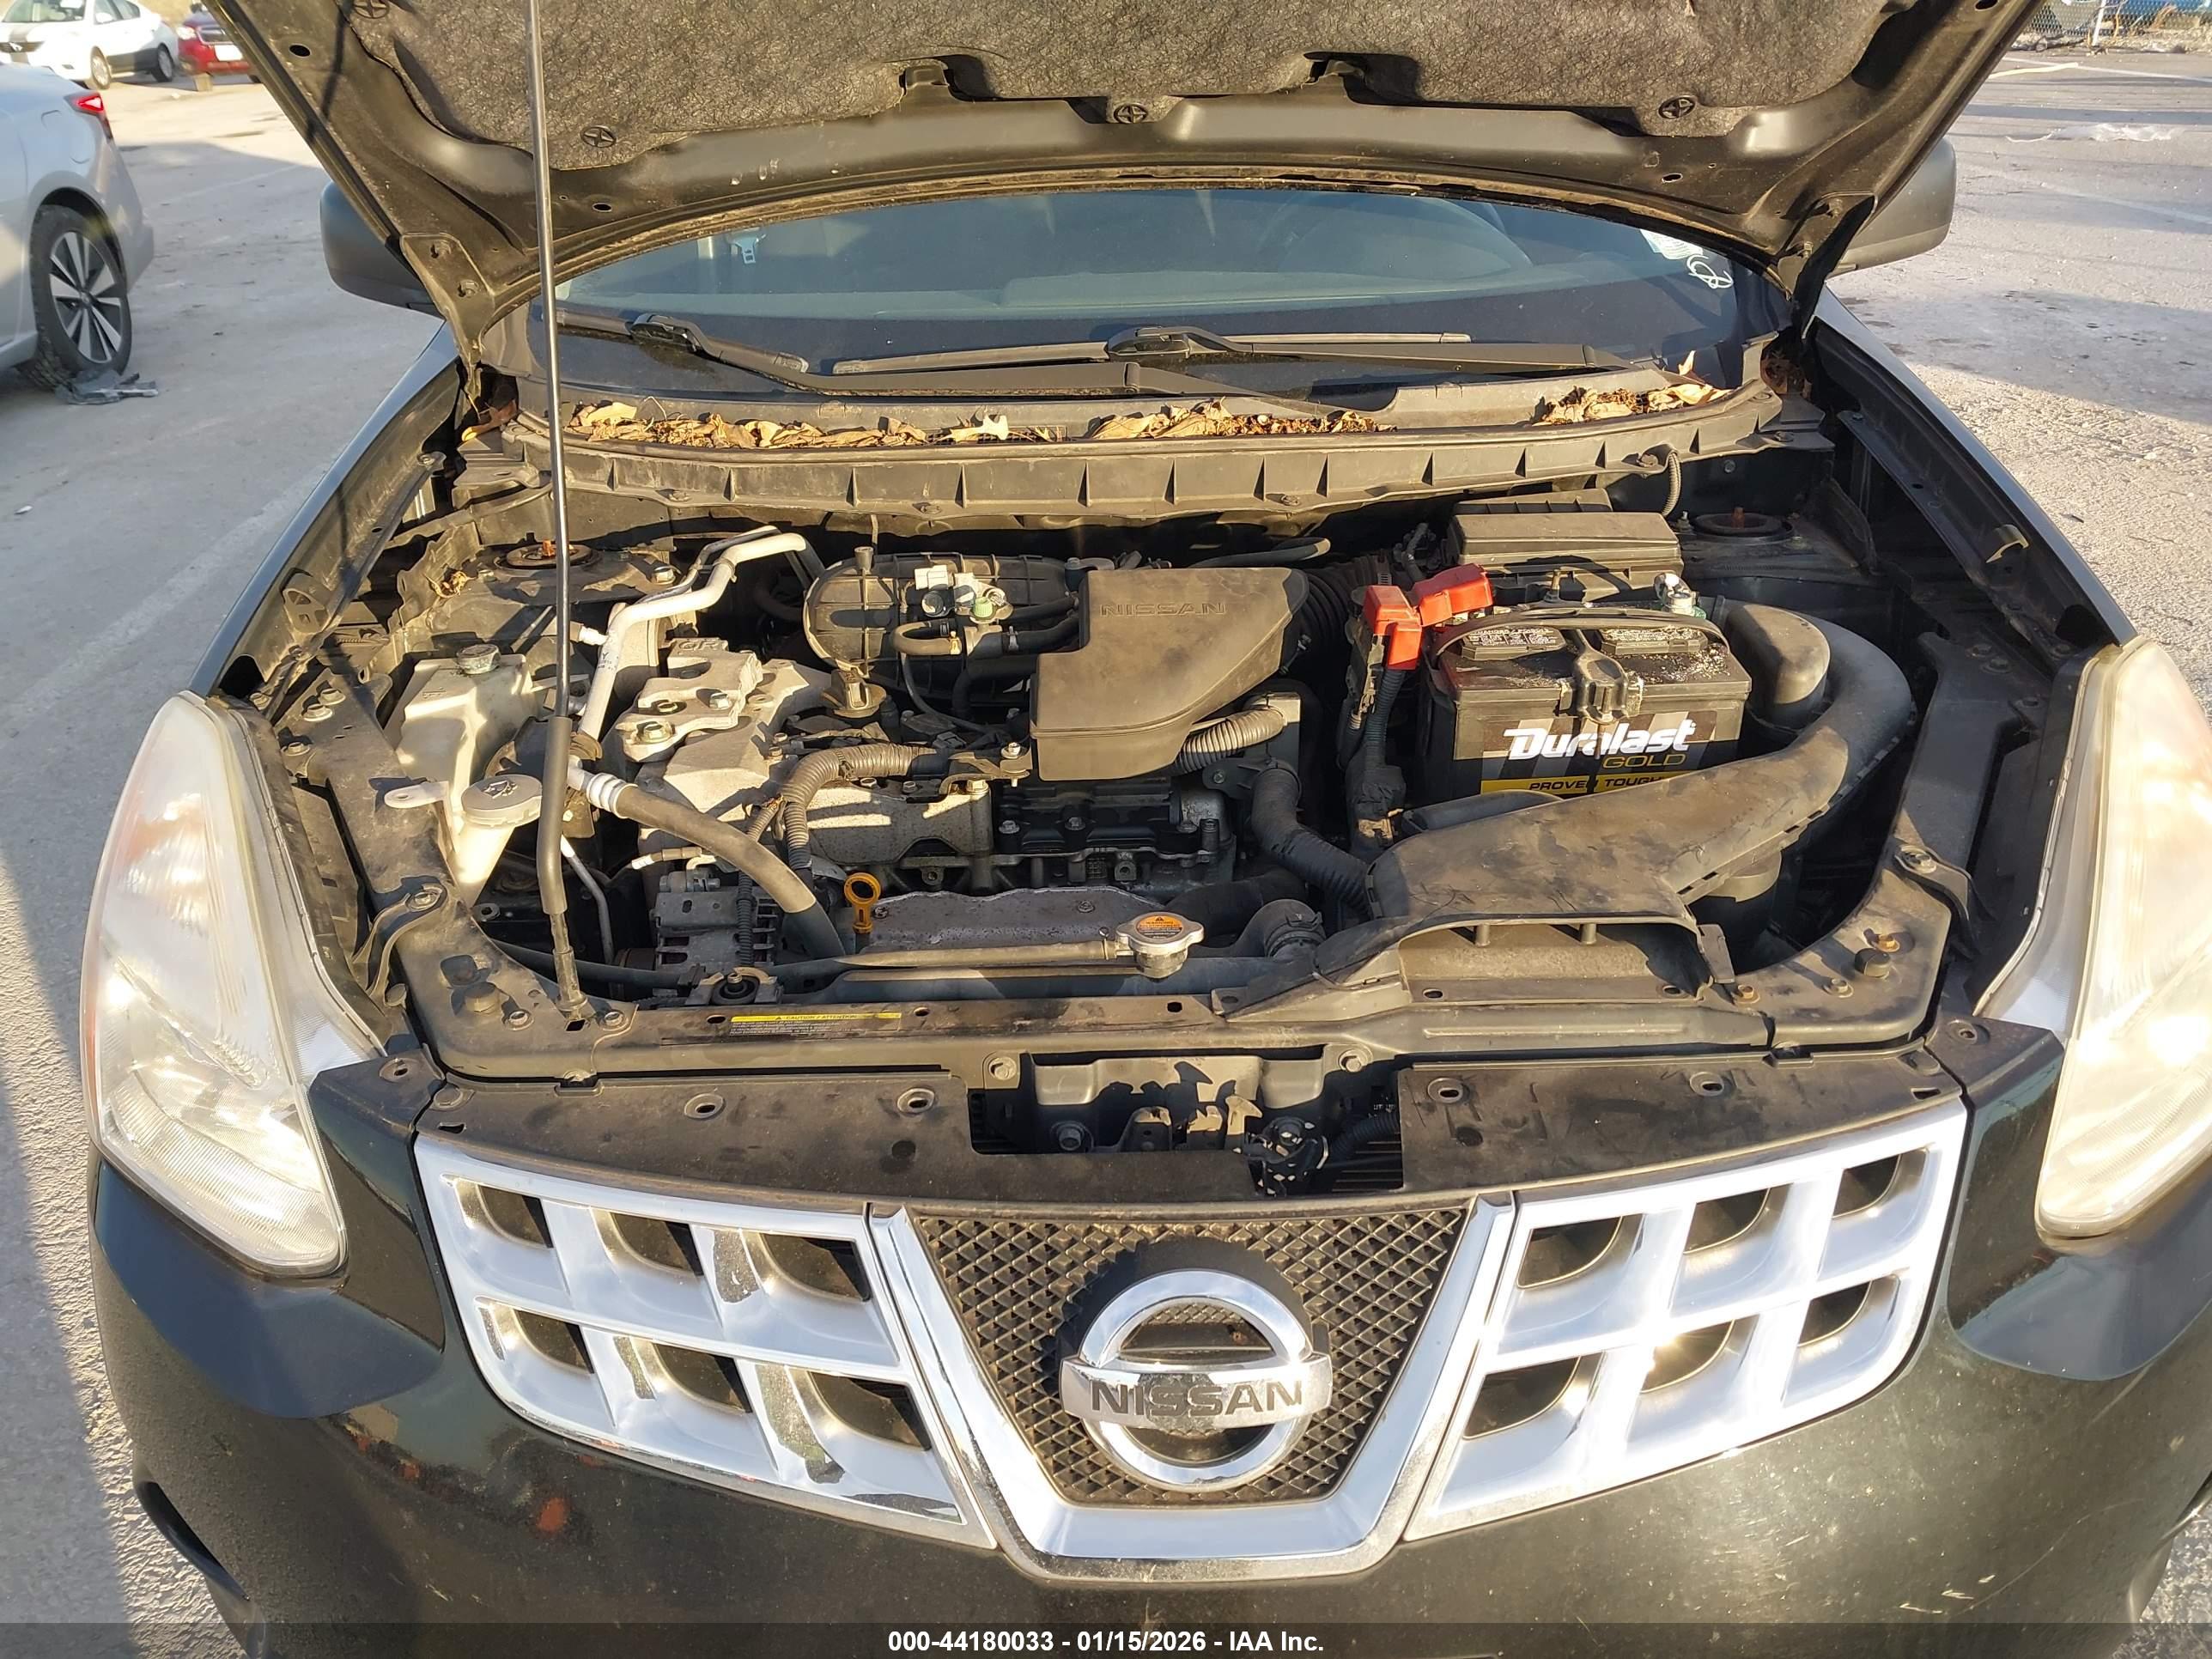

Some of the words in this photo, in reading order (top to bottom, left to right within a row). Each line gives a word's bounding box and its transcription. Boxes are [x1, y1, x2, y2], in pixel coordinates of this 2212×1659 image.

[1098, 603, 1227, 617] NISSAN
[1504, 720, 1697, 760] Duralast
[1602, 753, 1686, 769] GOLD
[1091, 1380, 1303, 1417] NISSAN
